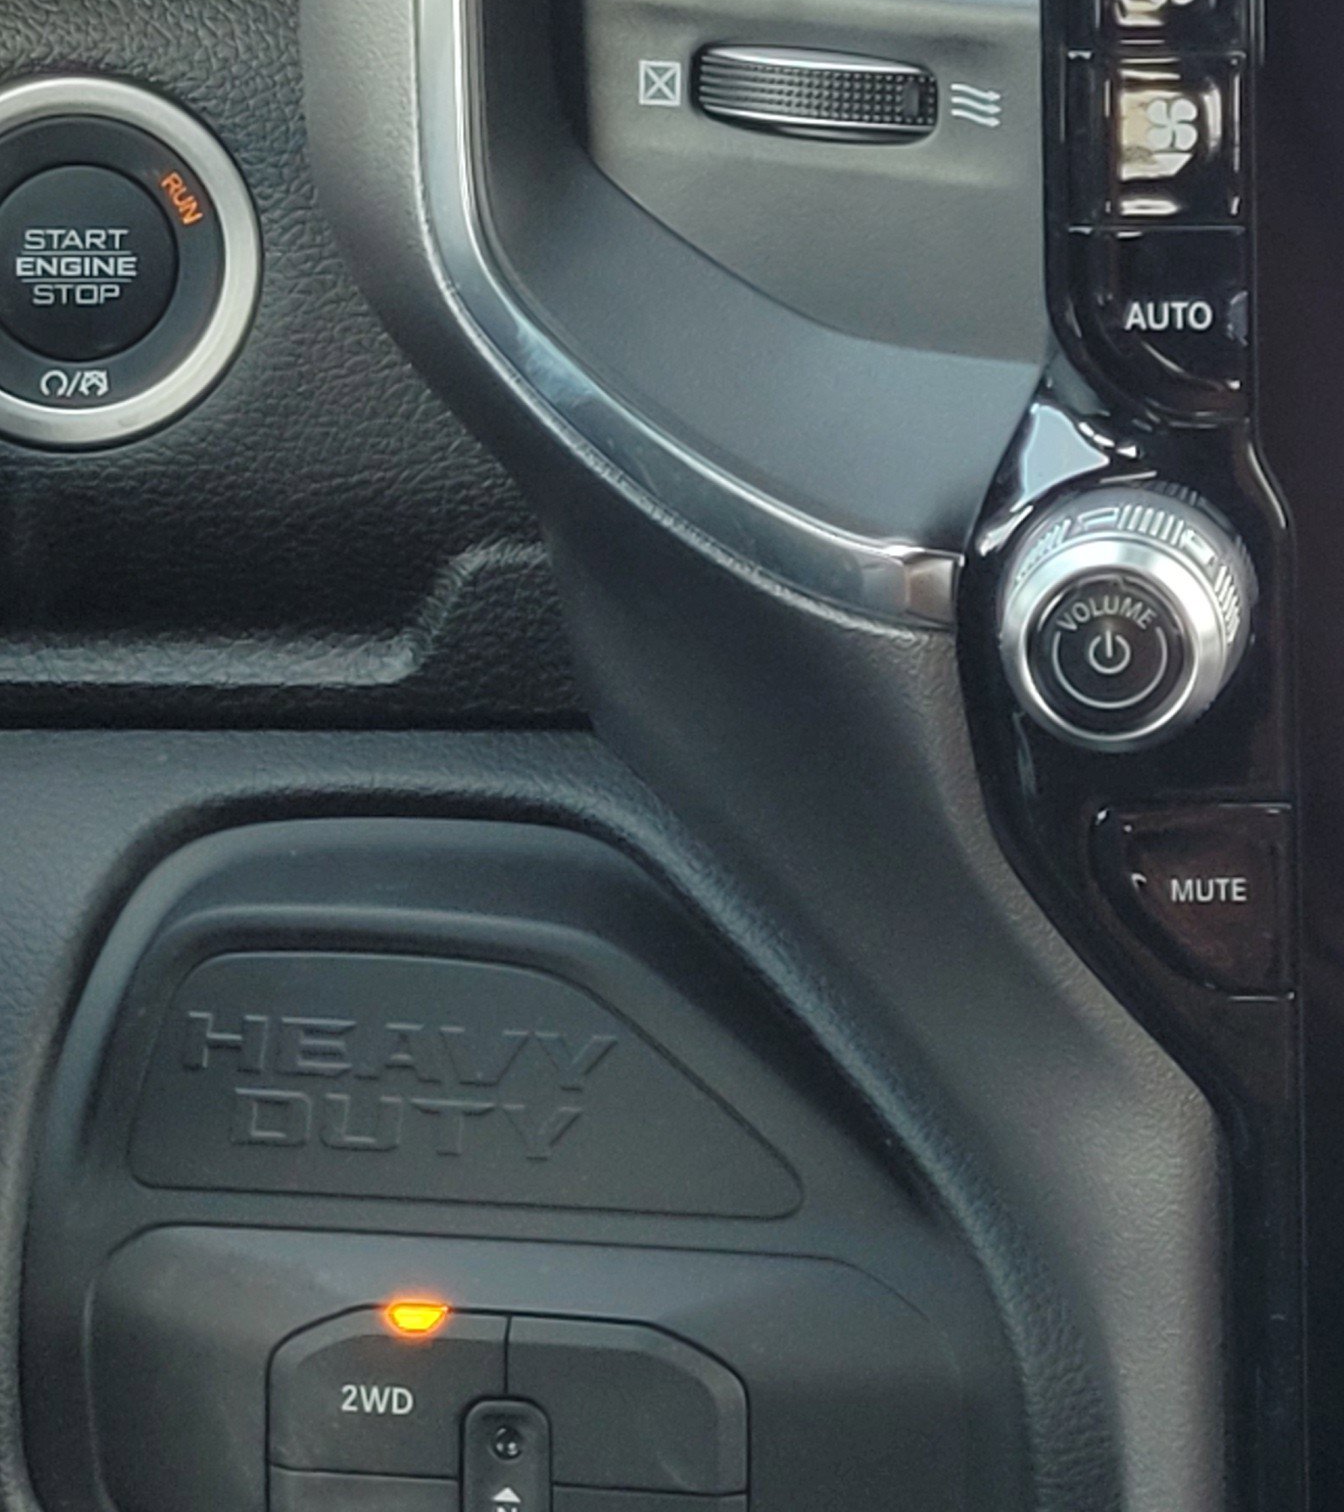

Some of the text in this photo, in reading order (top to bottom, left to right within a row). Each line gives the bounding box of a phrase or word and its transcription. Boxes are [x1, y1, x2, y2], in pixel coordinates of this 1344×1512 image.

[160, 171, 203, 225] RUN
[24, 229, 129, 250] START
[16, 257, 138, 277] ENGINE
[33, 285, 120, 305] STOP
[1125, 301, 1213, 331] AUTO
[1056, 595, 1157, 634] VOLUME
[1171, 878, 1248, 903] MUTE
[182, 1010, 619, 1092] HEAVY
[229, 1087, 585, 1161] DUTY
[341, 1383, 414, 1416] 2WD
